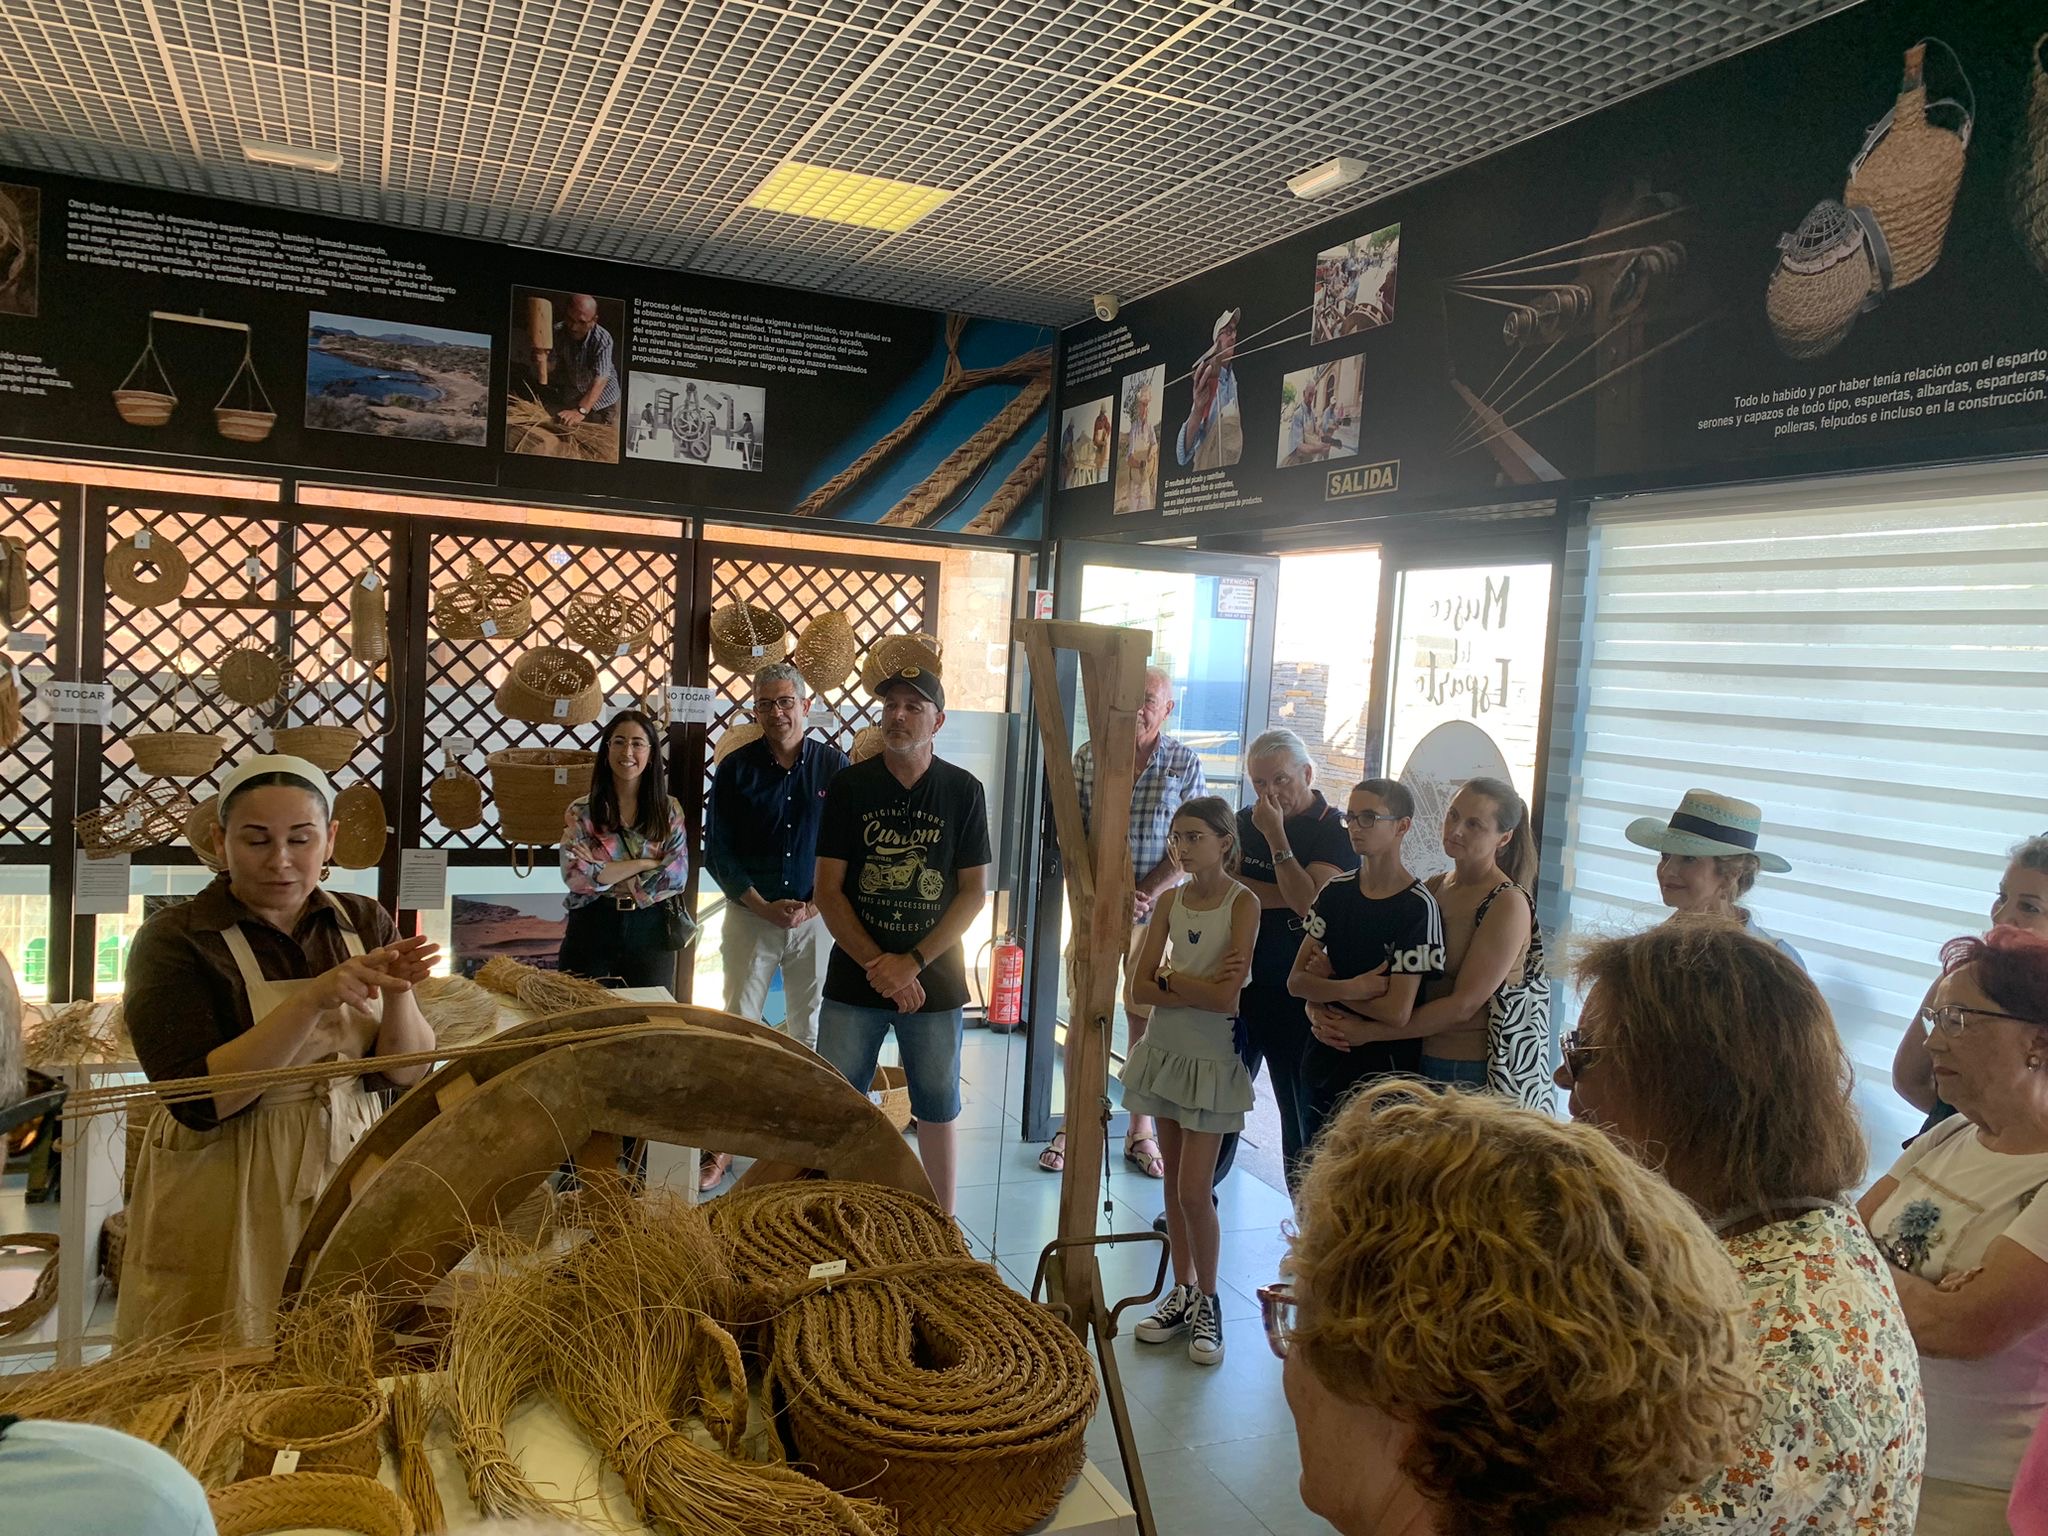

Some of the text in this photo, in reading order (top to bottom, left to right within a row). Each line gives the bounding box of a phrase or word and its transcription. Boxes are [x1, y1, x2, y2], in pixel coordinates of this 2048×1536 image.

[1734, 348, 2048, 407] Todo lo habido y por haber tenía relación con el esparto
[1698, 416, 1734, 429] serones
[1735, 415, 1742, 427] y
[1744, 409, 1784, 424] capazos
[1787, 404, 1800, 417] de
[1802, 401, 1826, 414] todo
[1828, 398, 1852, 413] tipo,
[1855, 389, 1913, 408] espuertas,
[1917, 381, 1972, 398] albardas,
[1774, 388, 2046, 438] polleras, felpudos e incluso en la construcción.
[1330, 466, 1393, 495] SALIDA
[45, 689, 105, 699] NO TOCAR
[680, 692, 710, 701] TOCAR
[862, 808, 906, 821] ORIGINA
[894, 900, 941, 910] ACCESSORIES
